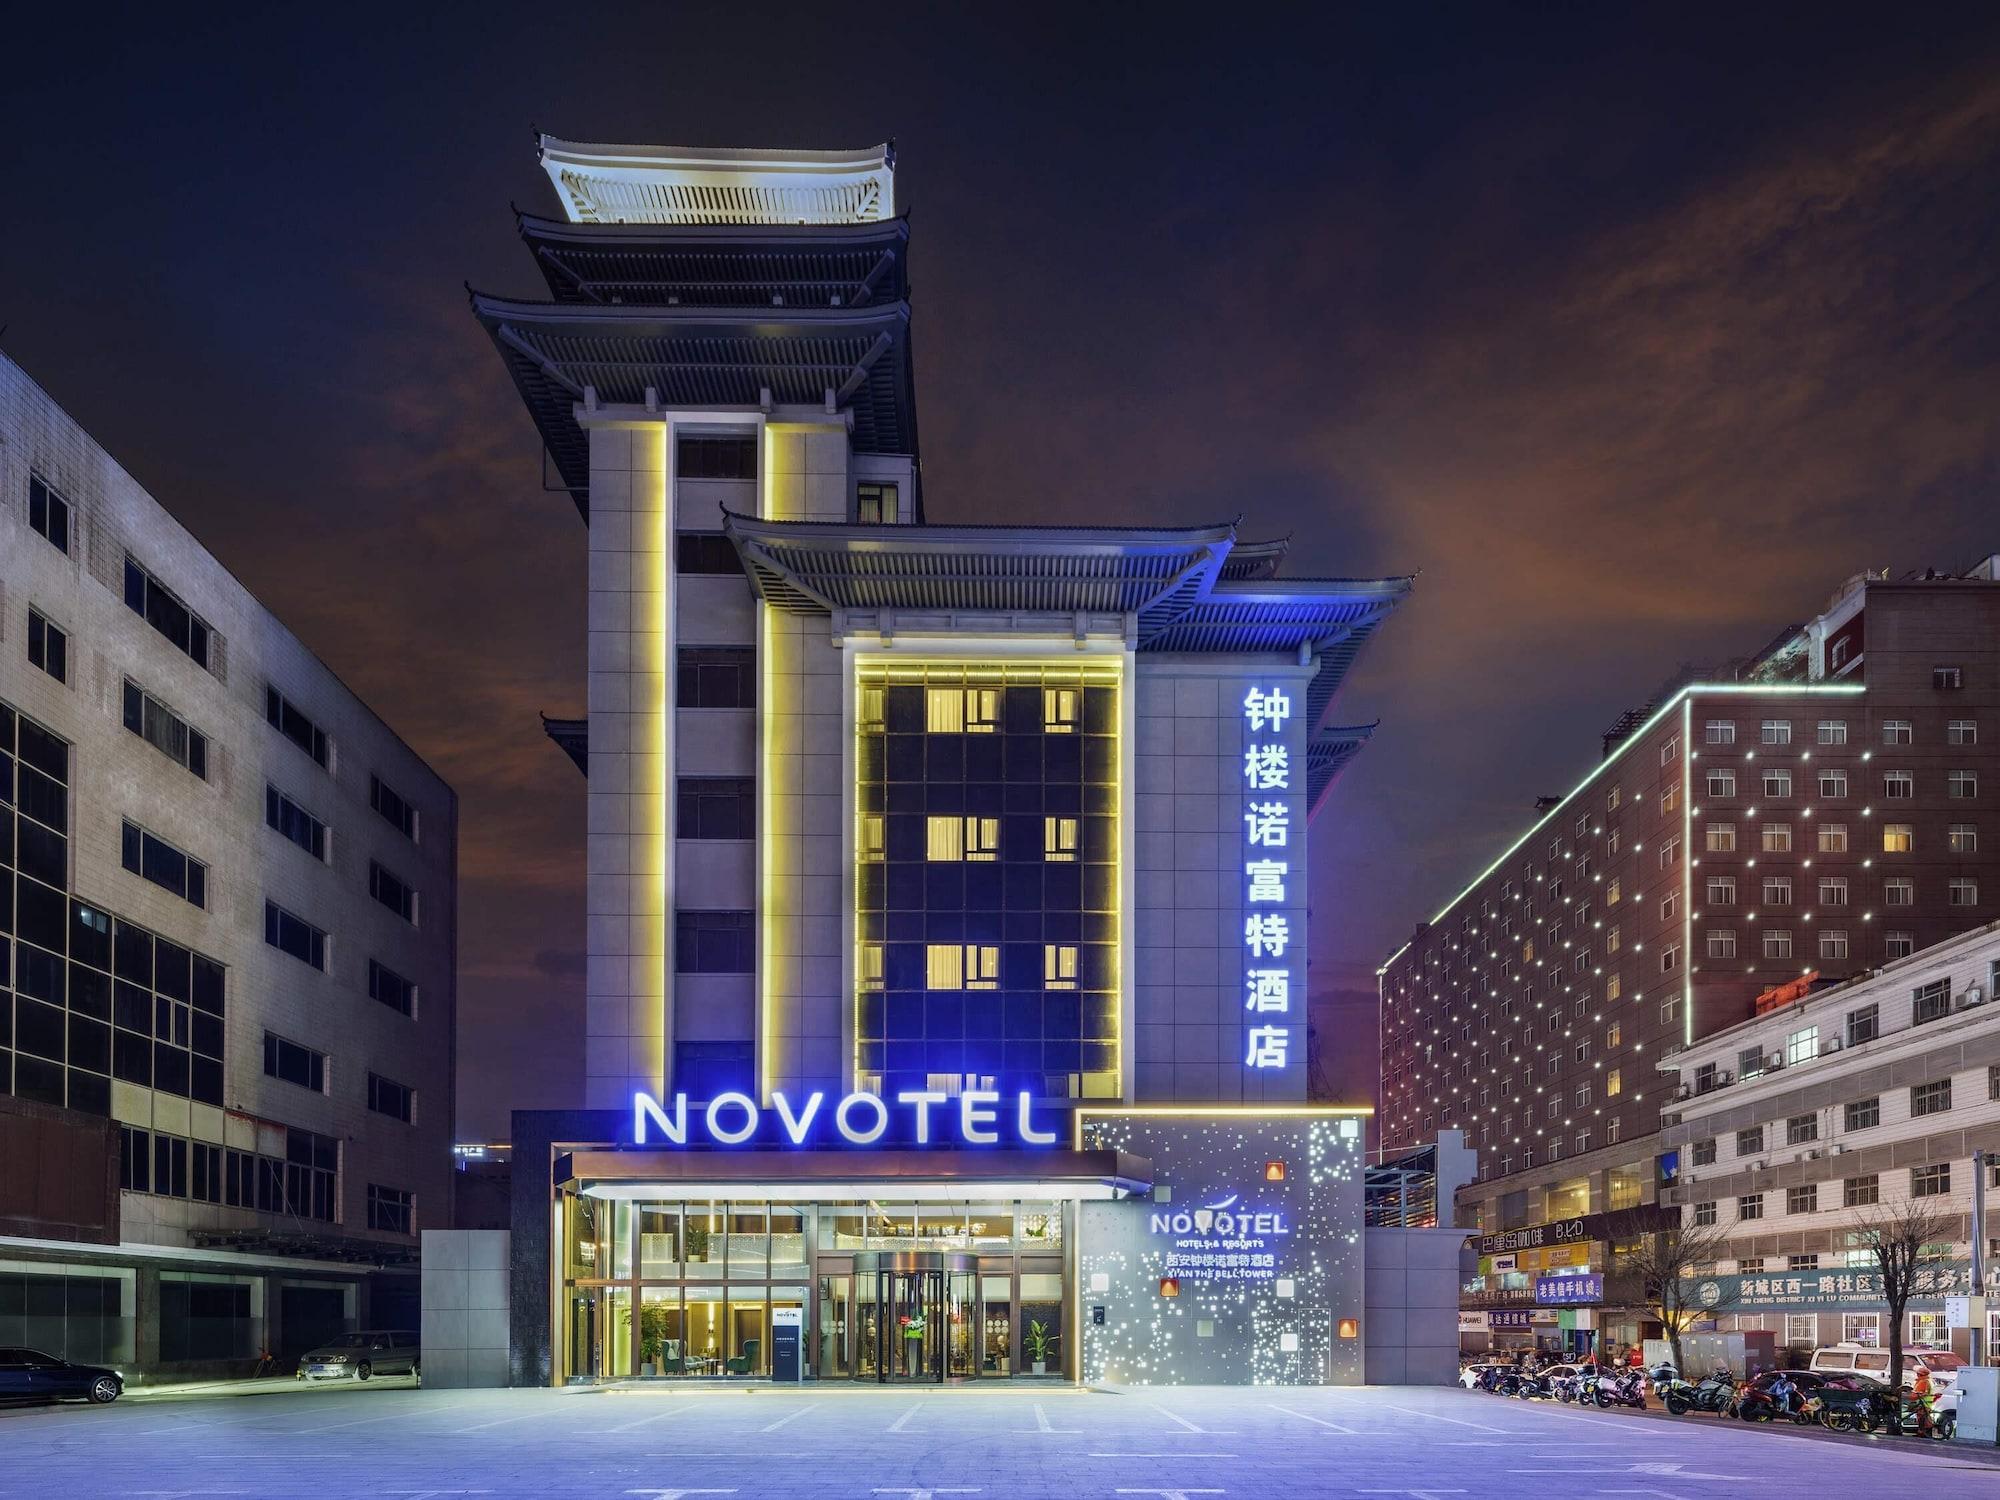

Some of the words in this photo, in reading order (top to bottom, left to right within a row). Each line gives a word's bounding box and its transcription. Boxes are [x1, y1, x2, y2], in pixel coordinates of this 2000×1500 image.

[1244, 687, 1290, 1069] 钟楼诺富特酒店
[635, 1091, 1056, 1144] NOVOTEL
[1151, 1213, 1289, 1235] NOVOTEL
[1176, 1240, 1209, 1249] HOTELS
[1223, 1240, 1264, 1249] RESORTS
[1482, 1227, 1543, 1253] 巴里岛咖啡
[1166, 1254, 1274, 1267] 西安钟楼诺富特酒店
[1195, 1269, 1213, 1278] THE
[1240, 1269, 1273, 1278] TOWER
